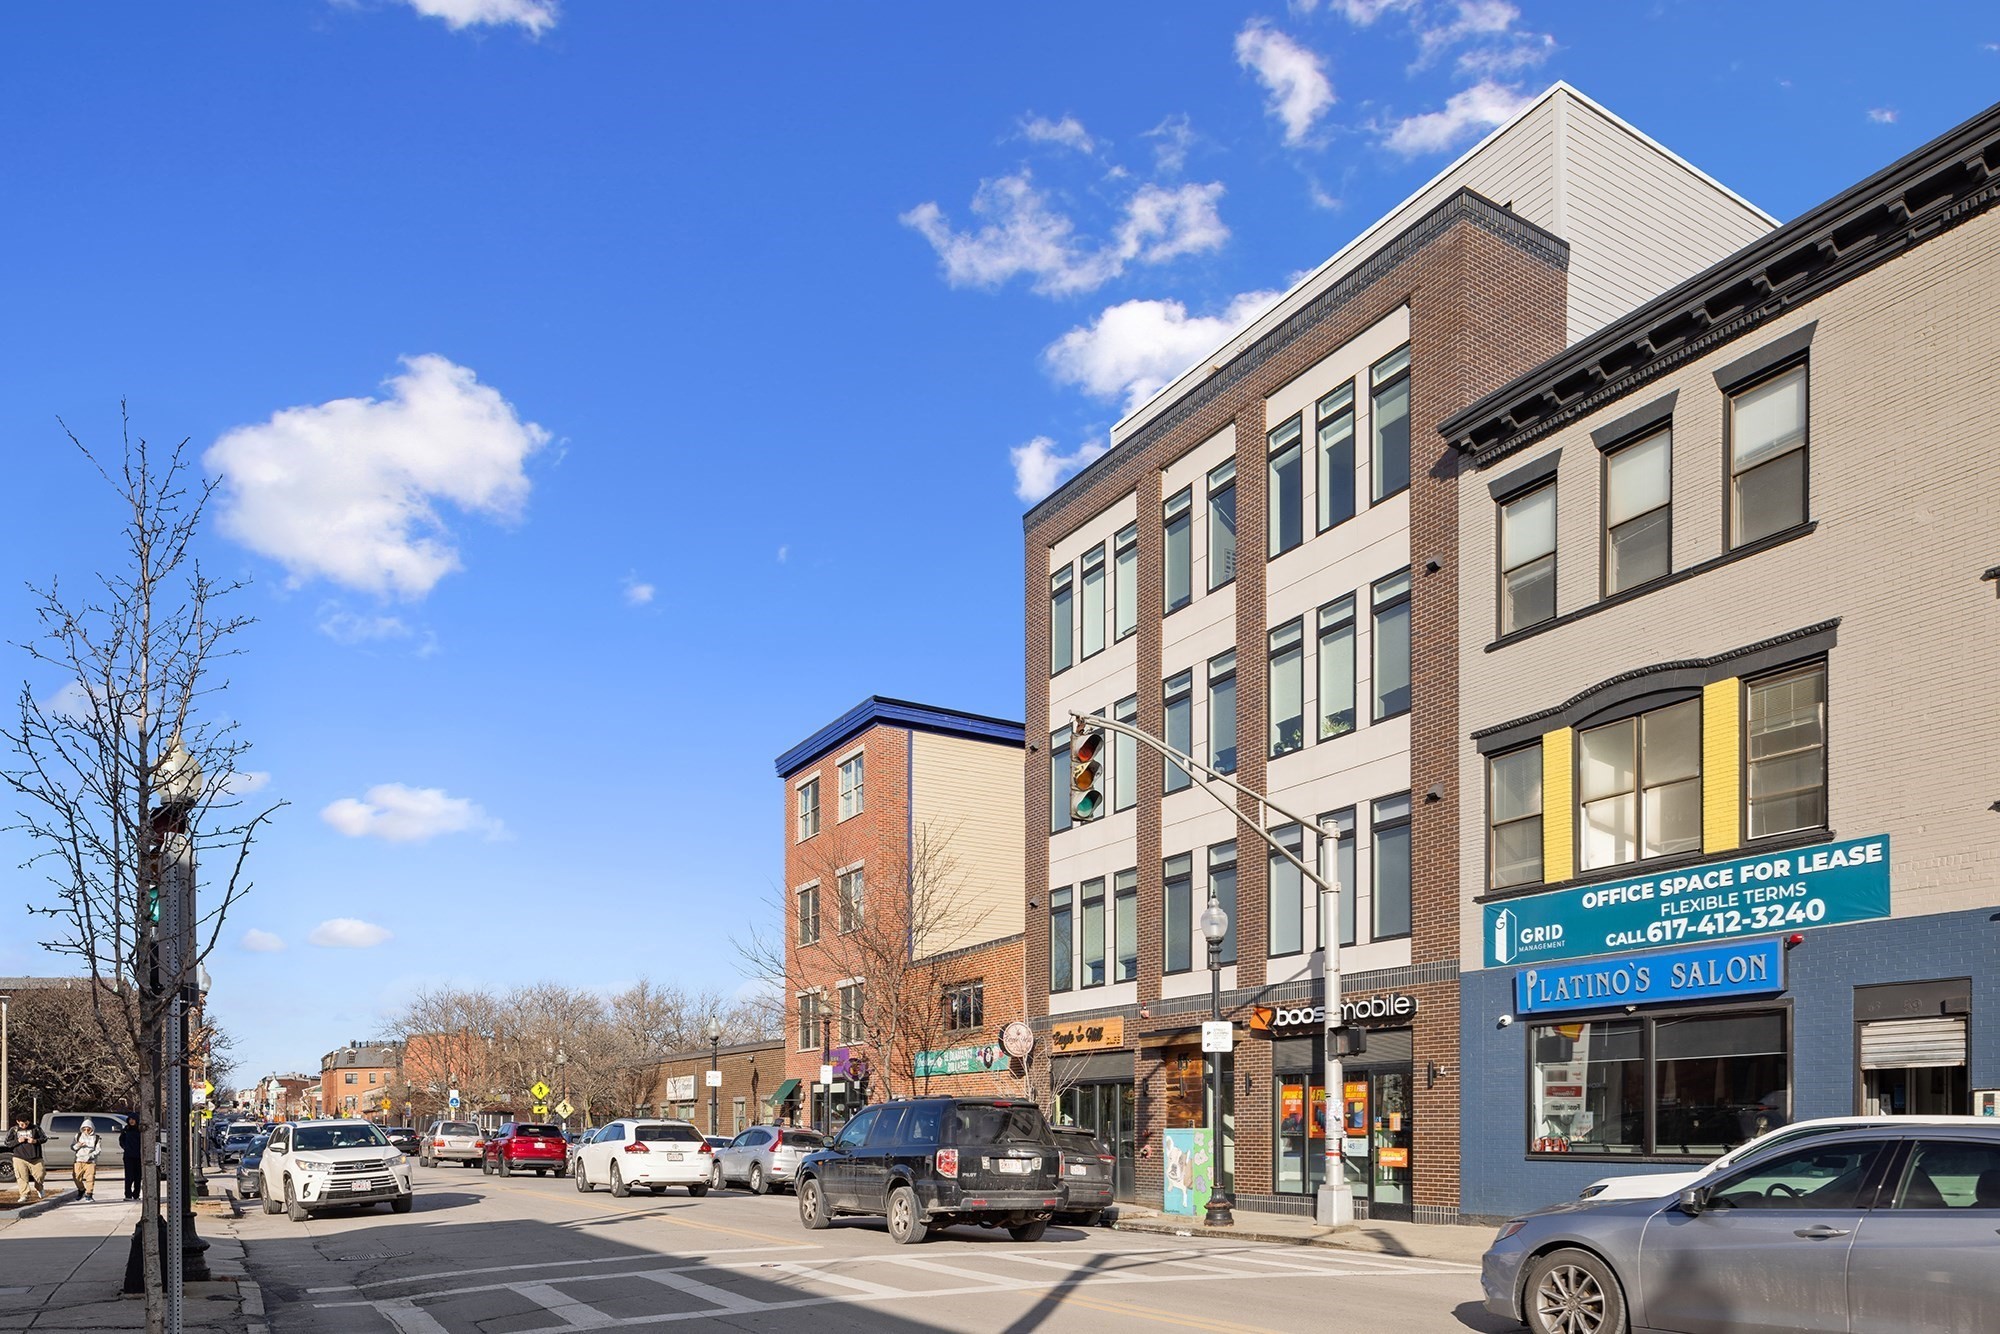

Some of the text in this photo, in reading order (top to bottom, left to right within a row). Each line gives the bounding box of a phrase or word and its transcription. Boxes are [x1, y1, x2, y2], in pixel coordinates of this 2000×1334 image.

[1582, 843, 1883, 909] OFFICE SPACE FOR LEASE
[1660, 882, 1807, 917] FLEXIBLE TERMS
[1520, 924, 1563, 944] GRID
[1605, 898, 1826, 947] CALL 617-412-3240
[1518, 940, 1566, 953] MANAGEMENT
[1670, 953, 1767, 989] SALON
[1275, 993, 1410, 1027] boos mobile
[1052, 1026, 1104, 1050] Eagle Hill
[1532, 1136, 1569, 1152] OPEN
